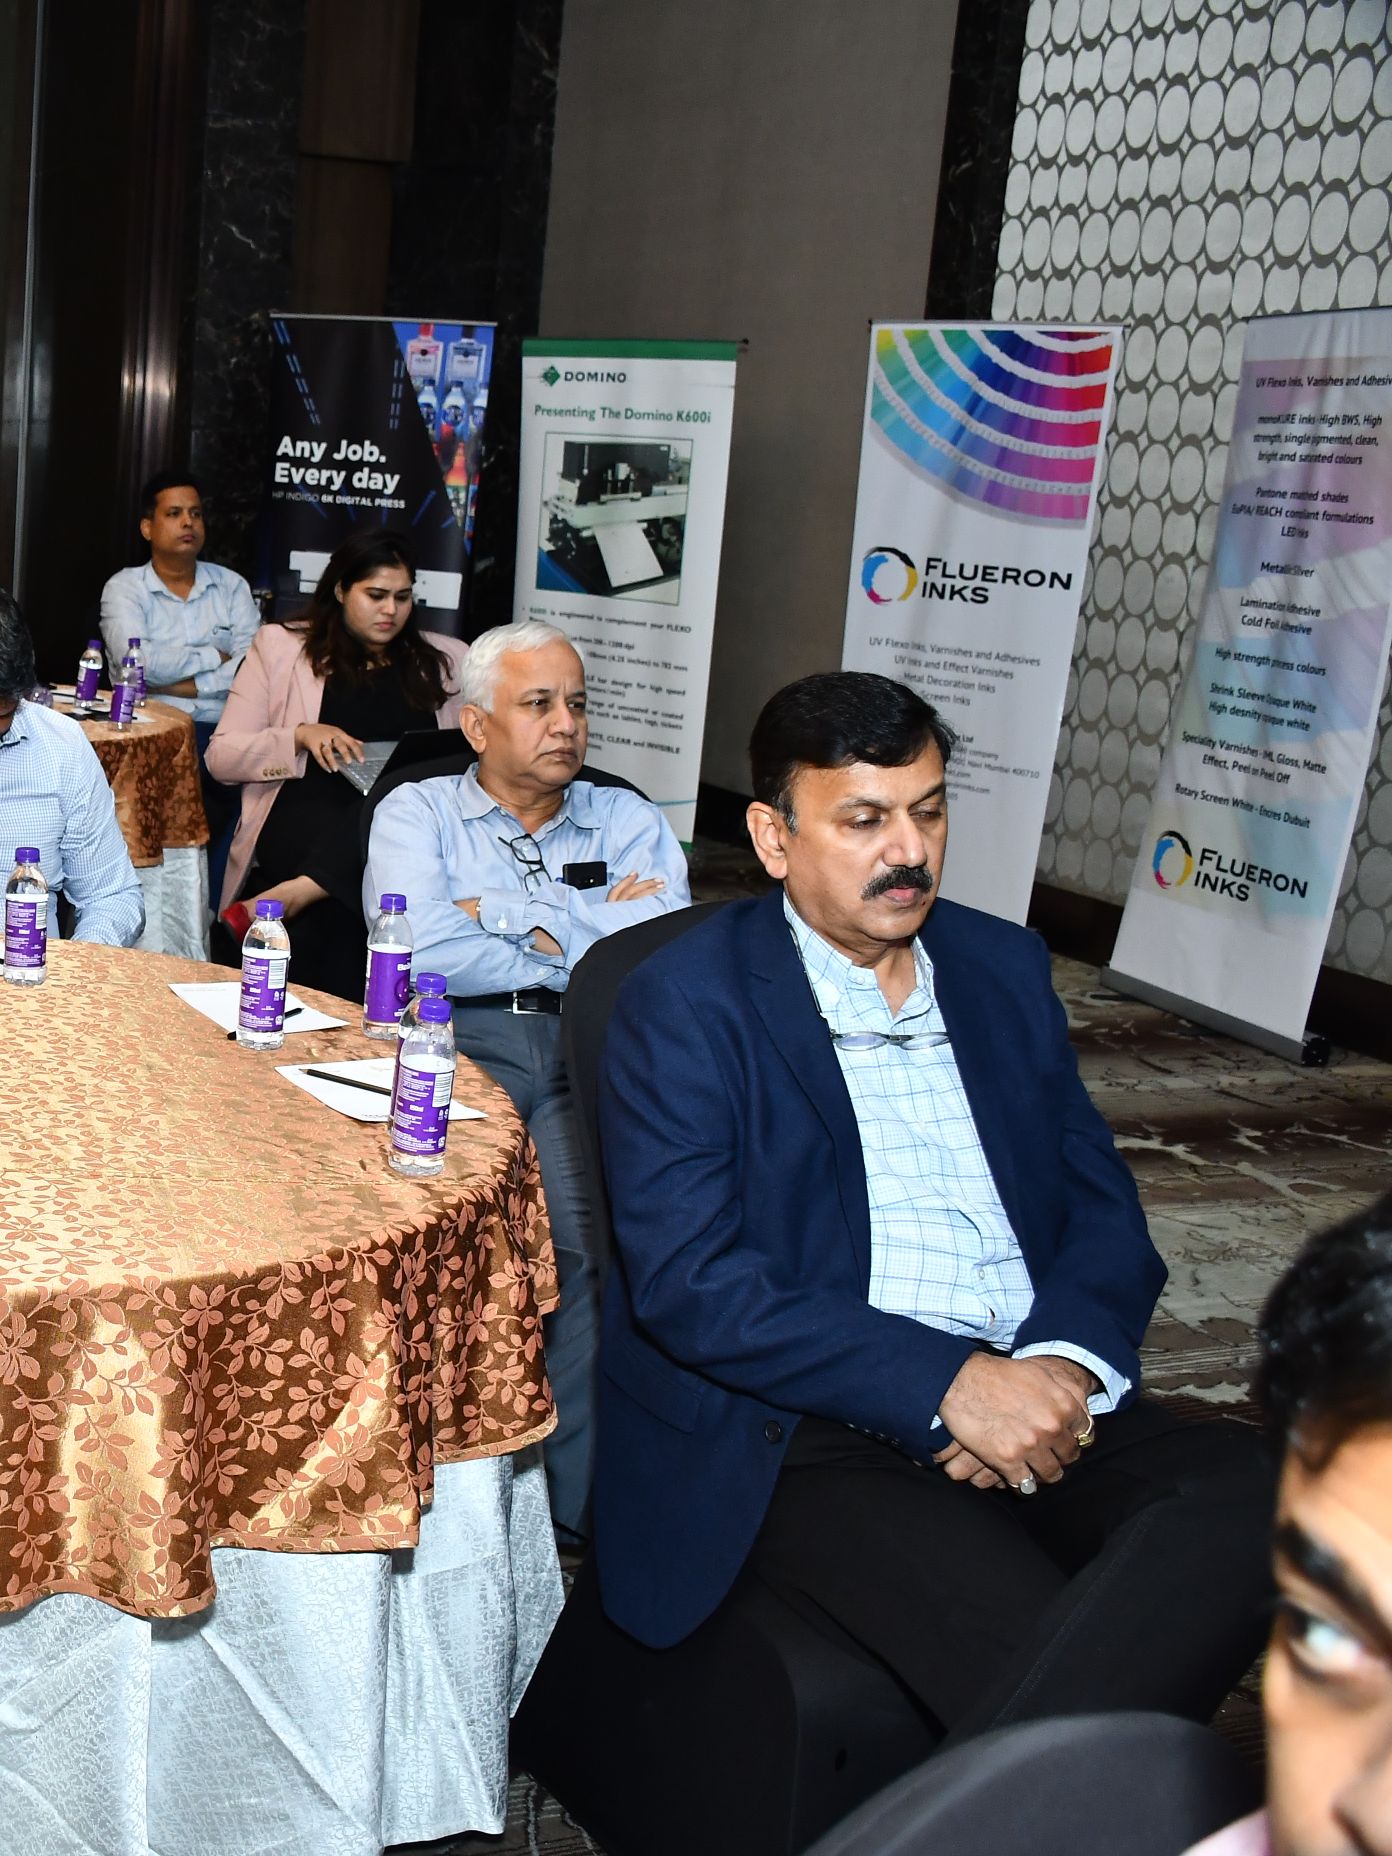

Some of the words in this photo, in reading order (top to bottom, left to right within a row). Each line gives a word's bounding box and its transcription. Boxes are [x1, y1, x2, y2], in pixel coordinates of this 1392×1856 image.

[564, 371, 627, 383] DOMINO
[534, 404, 596, 421] Presenting
[600, 407, 621, 419] The
[624, 408, 673, 421] Domino
[676, 410, 711, 423] K600i
[1363, 414, 1383, 429] High
[276, 435, 327, 462] Any
[332, 439, 386, 463] Job.
[1284, 432, 1311, 446] single
[1279, 452, 1297, 462] and
[1335, 453, 1363, 465] colours
[274, 462, 347, 491] Every
[352, 467, 401, 495] day
[286, 492, 320, 503] INDIGO
[321, 494, 334, 504] 6K
[336, 495, 373, 507] DIGITAL
[374, 498, 406, 509] PRESS
[1321, 491, 1349, 503] shades
[924, 557, 1073, 590] FLUERON
[921, 581, 989, 604] INKS
[667, 624, 692, 634] FLEXO
[1241, 614, 1263, 628] Cold
[1264, 617, 1280, 630] Foil
[869, 636, 883, 646] UV
[930, 643, 973, 659] Varnishes
[975, 650, 992, 660] and
[994, 651, 1041, 667] Adhesives
[894, 654, 907, 664] UV
[924, 658, 941, 669] and
[943, 660, 969, 673] Effect
[971, 665, 1014, 680] Varnishes
[1233, 652, 1271, 668] strength
[1296, 662, 1327, 677] colours
[927, 675, 976, 690] Decoration
[977, 682, 996, 694] Inks
[953, 696, 971, 707] Inks
[1292, 697, 1317, 714] White
[1208, 700, 1228, 716] High
[1286, 717, 1311, 732] white
[607, 735, 631, 745] CLEAR
[646, 741, 681, 755] INVISIBLE
[1202, 753, 1229, 771] Effect,
[1231, 760, 1251, 776] Peel
[1276, 772, 1291, 785] Off
[1276, 753, 1301, 769] Gloss,
[1302, 759, 1327, 775] Matte
[1175, 783, 1200, 800] Rotary
[1201, 790, 1230, 806] Screen
[1232, 797, 1254, 813] White
[1283, 812, 1311, 829] Dubuit
[1199, 848, 1309, 899] FLUERON
[1194, 871, 1250, 902] INKS
